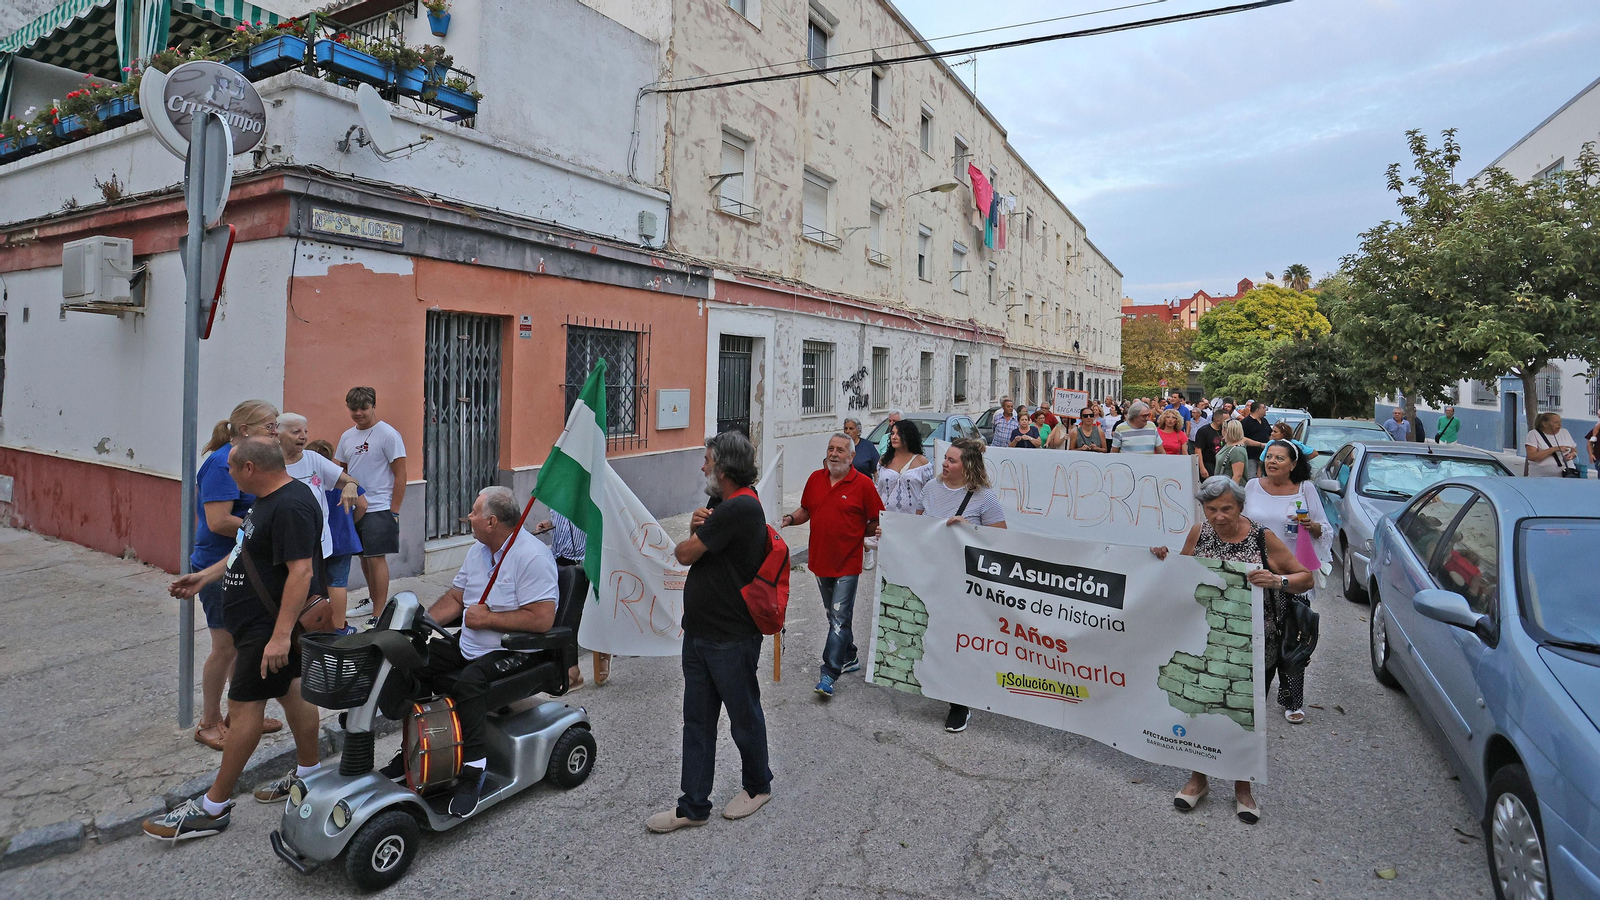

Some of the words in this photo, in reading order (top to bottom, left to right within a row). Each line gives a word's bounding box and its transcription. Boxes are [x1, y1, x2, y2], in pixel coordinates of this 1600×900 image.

[977, 555, 1002, 576] La
[1009, 562, 1109, 598] Asunción
[965, 580, 983, 597] 70
[986, 588, 1027, 611] Años
[1030, 599, 1053, 617] de
[1058, 603, 1126, 633] historia
[998, 617, 1011, 635] 2
[1014, 623, 1068, 653] Años
[956, 633, 1008, 656] para
[1015, 646, 1126, 688] arruinarla
[1001, 672, 1056, 693] ¡Solución
[1057, 681, 1080, 698] YA!
[1142, 729, 1178, 745] AFECTADOS
[1178, 739, 1193, 747] POR
[1202, 745, 1222, 755] OBRA
[1146, 738, 1175, 751] BARRIADA
